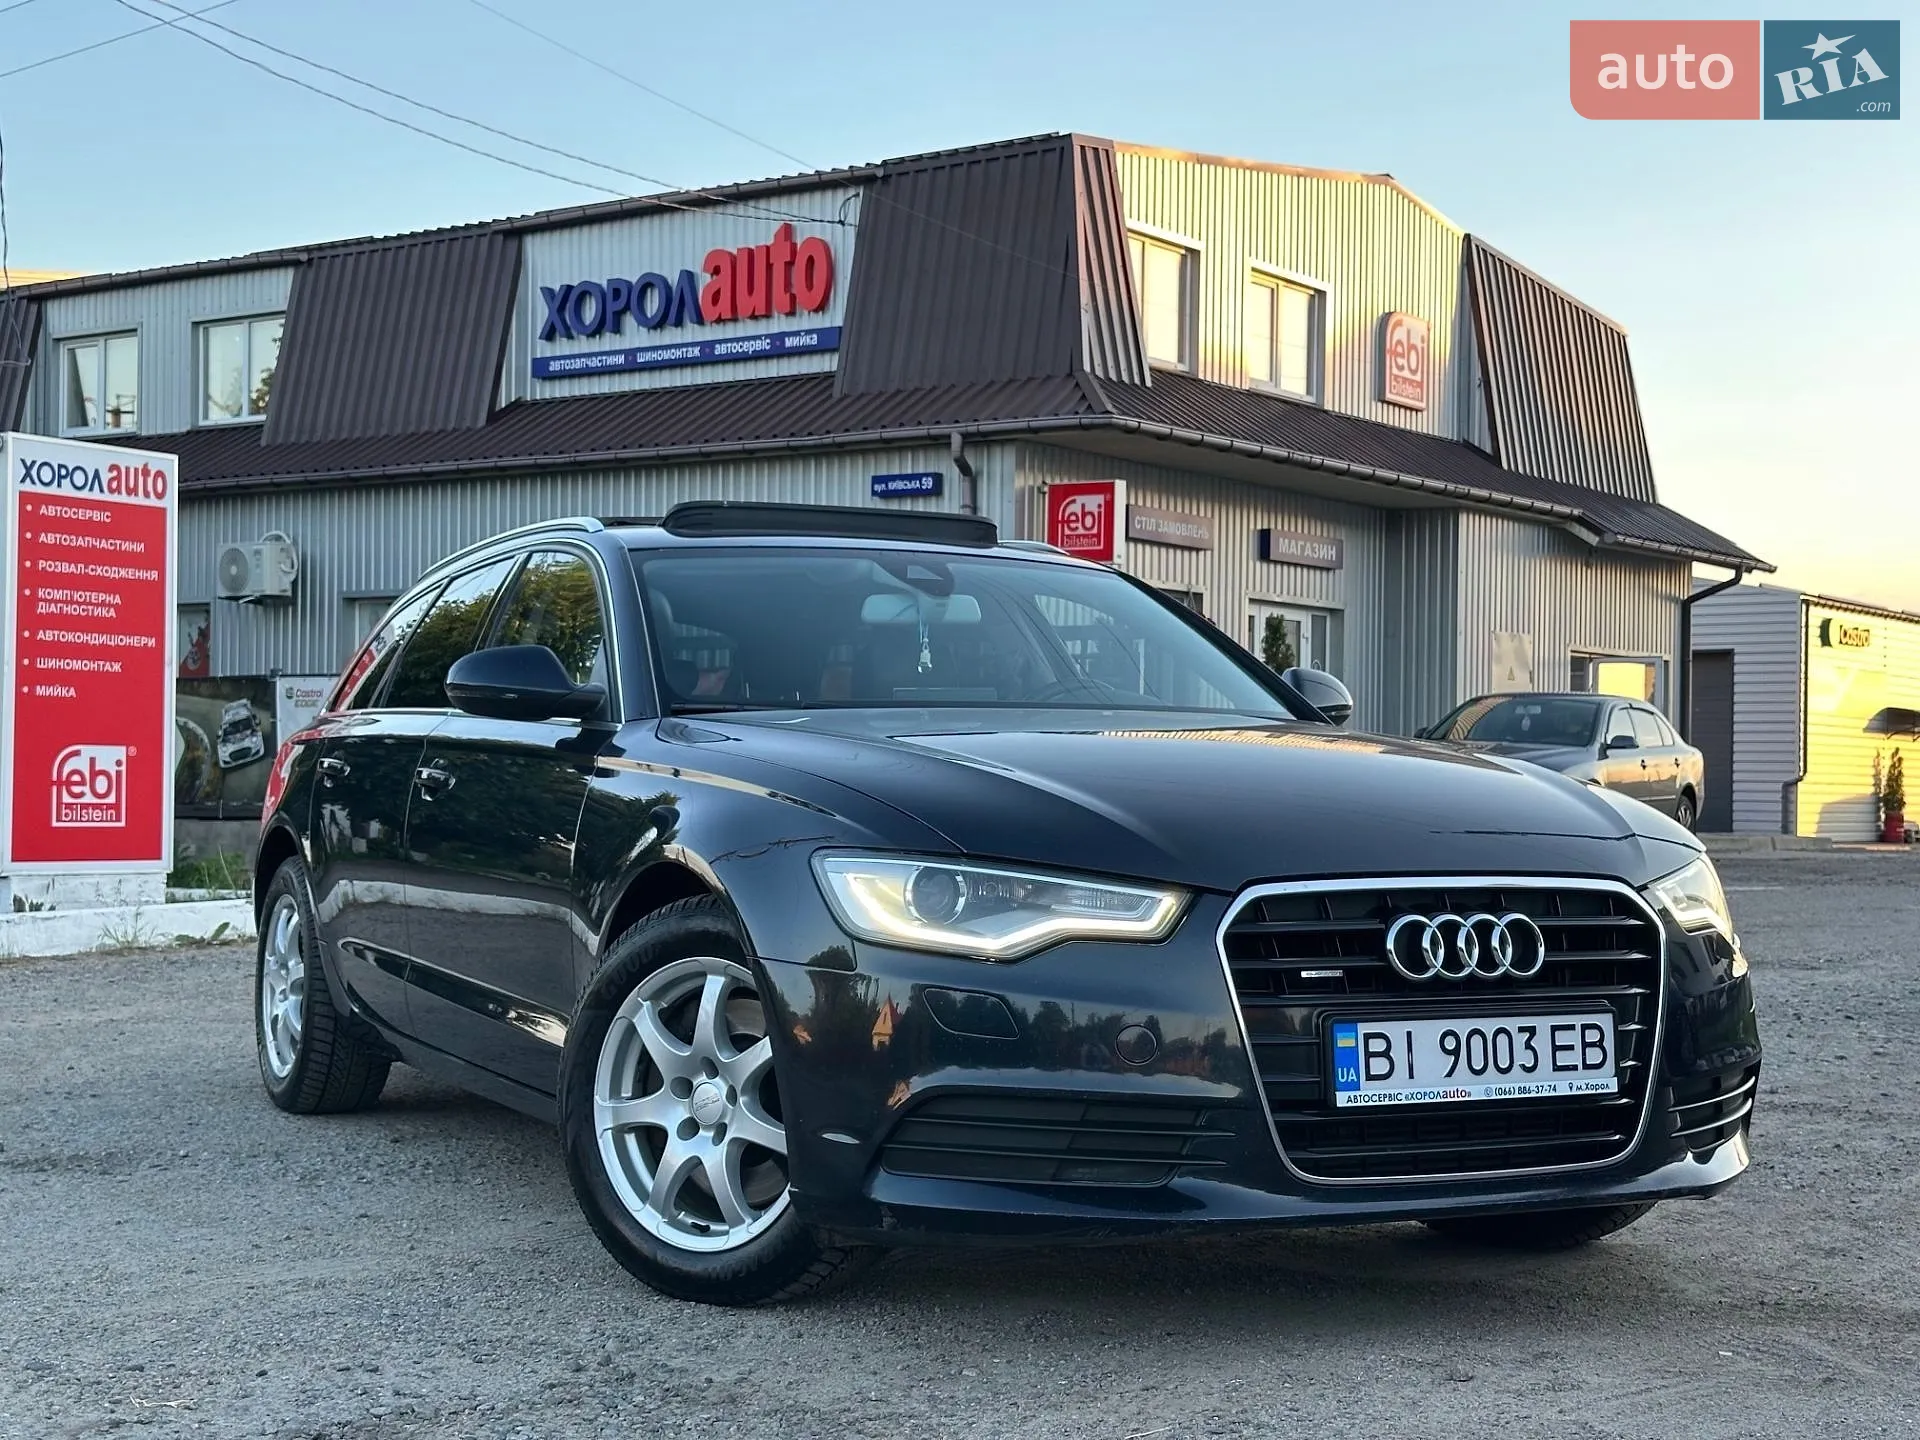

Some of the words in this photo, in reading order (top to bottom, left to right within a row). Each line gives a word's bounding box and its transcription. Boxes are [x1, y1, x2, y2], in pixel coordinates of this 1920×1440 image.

[548, 353, 625, 371] автозапчастини
[636, 345, 701, 363] шиномонтаж
[714, 336, 772, 355] автосервіс
[784, 332, 818, 348] мийка
[1387, 318, 1425, 377] febi
[921, 476, 933, 489] 59
[40, 504, 112, 523] АВТОСЕРВІС
[1058, 498, 1103, 534] febi
[1134, 515, 1157, 532] СТІЛ
[1157, 519, 1209, 540] ЗАМОВЛЕНЬ
[39, 532, 145, 553] АВТОЗАПЧАСТИНИ
[1063, 535, 1098, 548] bilstein
[1278, 537, 1337, 561] МАГАЗИН
[38, 560, 159, 582] РОЗВАЛ-СХОДЖЕННЯ
[38, 587, 122, 605] КОМП'ЮТЕРНА
[37, 602, 117, 619] ДІАГНОСТИКА
[37, 629, 156, 648] АВТОКОНДИЦІОНЕРИ
[1840, 625, 1870, 647] Castro
[36, 657, 122, 673] ШИНОМОНТАЖ
[36, 684, 77, 698] МИЙКА
[52, 749, 124, 801] febi
[61, 804, 116, 821] bilstein
[1363, 1030, 1415, 1082] BI
[1439, 1025, 1540, 1078] 9003
[1551, 1022, 1609, 1072] EB
[1338, 1067, 1357, 1082] UA
[1346, 1092, 1403, 1104] АВТОСЕРВІС
[1494, 1086, 1516, 1097] (066)
[1517, 1083, 1558, 1096] 886-37-74
